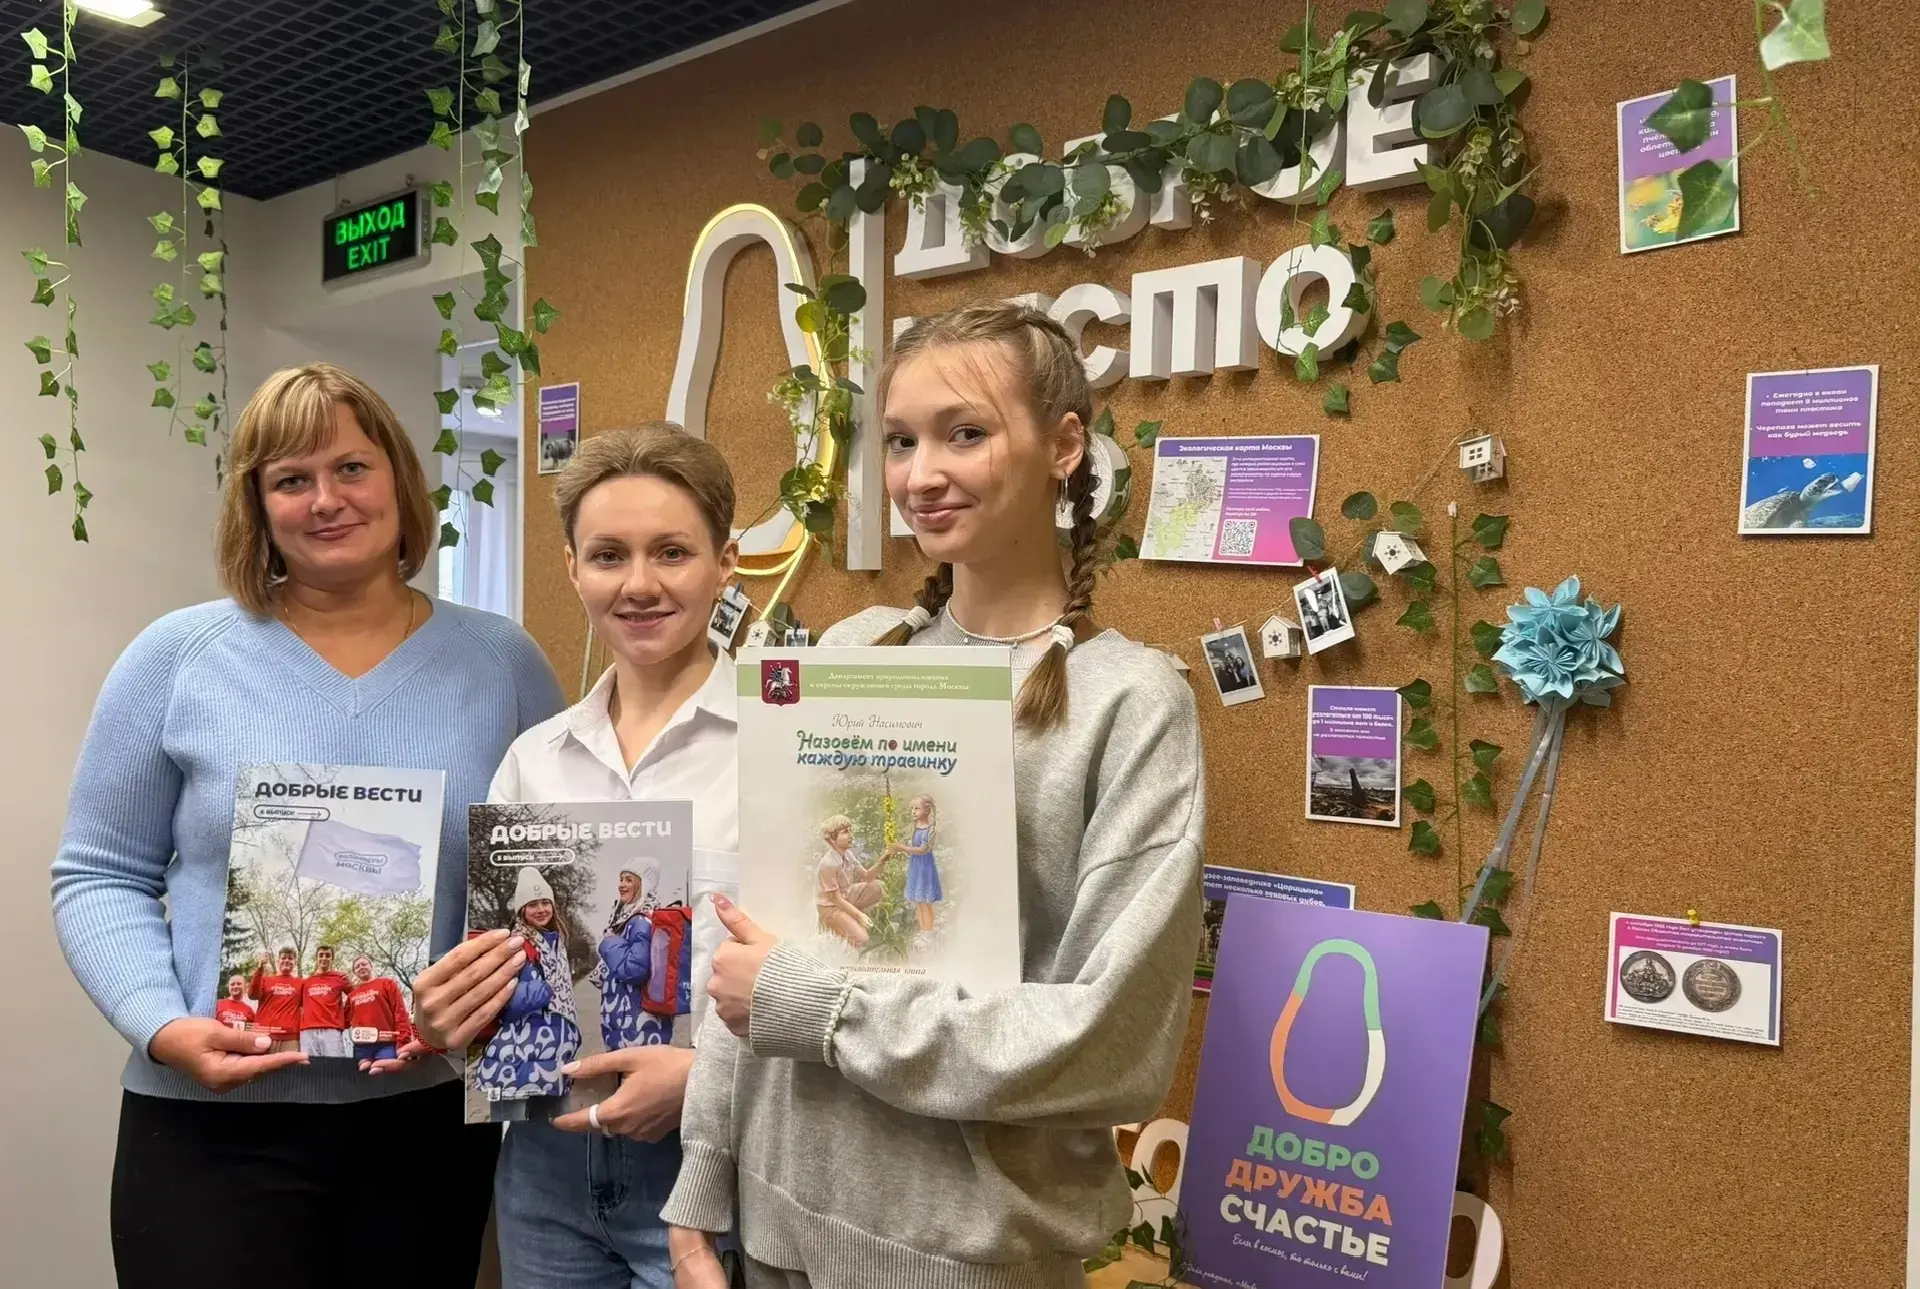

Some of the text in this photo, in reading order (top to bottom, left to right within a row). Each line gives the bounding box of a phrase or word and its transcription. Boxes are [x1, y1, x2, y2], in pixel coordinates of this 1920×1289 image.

[336, 200, 404, 245] ВЫХОД
[348, 236, 390, 269] EXIT
[1761, 399, 1804, 408] попадает
[1812, 396, 1859, 404] миллионов
[1772, 391, 1813, 399] Ежегодно
[1756, 424, 1795, 432] Черепаха
[1784, 430, 1811, 439] бурый
[1812, 430, 1848, 438] медведь
[1235, 444, 1260, 452] карта
[828, 672, 948, 682] Департамент природопользования
[843, 682, 890, 691] окружающей
[832, 713, 923, 731] Юрий Насимович
[796, 730, 957, 753] Назовём по имени
[796, 750, 958, 775] каждую травинку
[255, 782, 422, 803] ДОБРЫЕ ВЕСТИ
[266, 809, 295, 817] ВЫПУСК
[490, 820, 672, 845] ДОБРЫЕ ВЕСТИ
[336, 862, 382, 875] МОСКВЫ
[1203, 872, 1324, 895] узее-заповеднике «Царицыно»
[1203, 881, 1222, 889] тет
[1223, 884, 1263, 895] несколько
[904, 967, 926, 975] книга
[1246, 1125, 1380, 1180] ДОБРО
[1224, 1158, 1393, 1226] ДРУЖБА
[1219, 1194, 1392, 1266] СЧАСТЬЕ
[1232, 1233, 1252, 1248] Если
[1253, 1239, 1260, 1249] в
[1260, 1246, 1288, 1260] космос,
[1303, 1257, 1332, 1272] только
[1340, 1265, 1368, 1281] вами!
